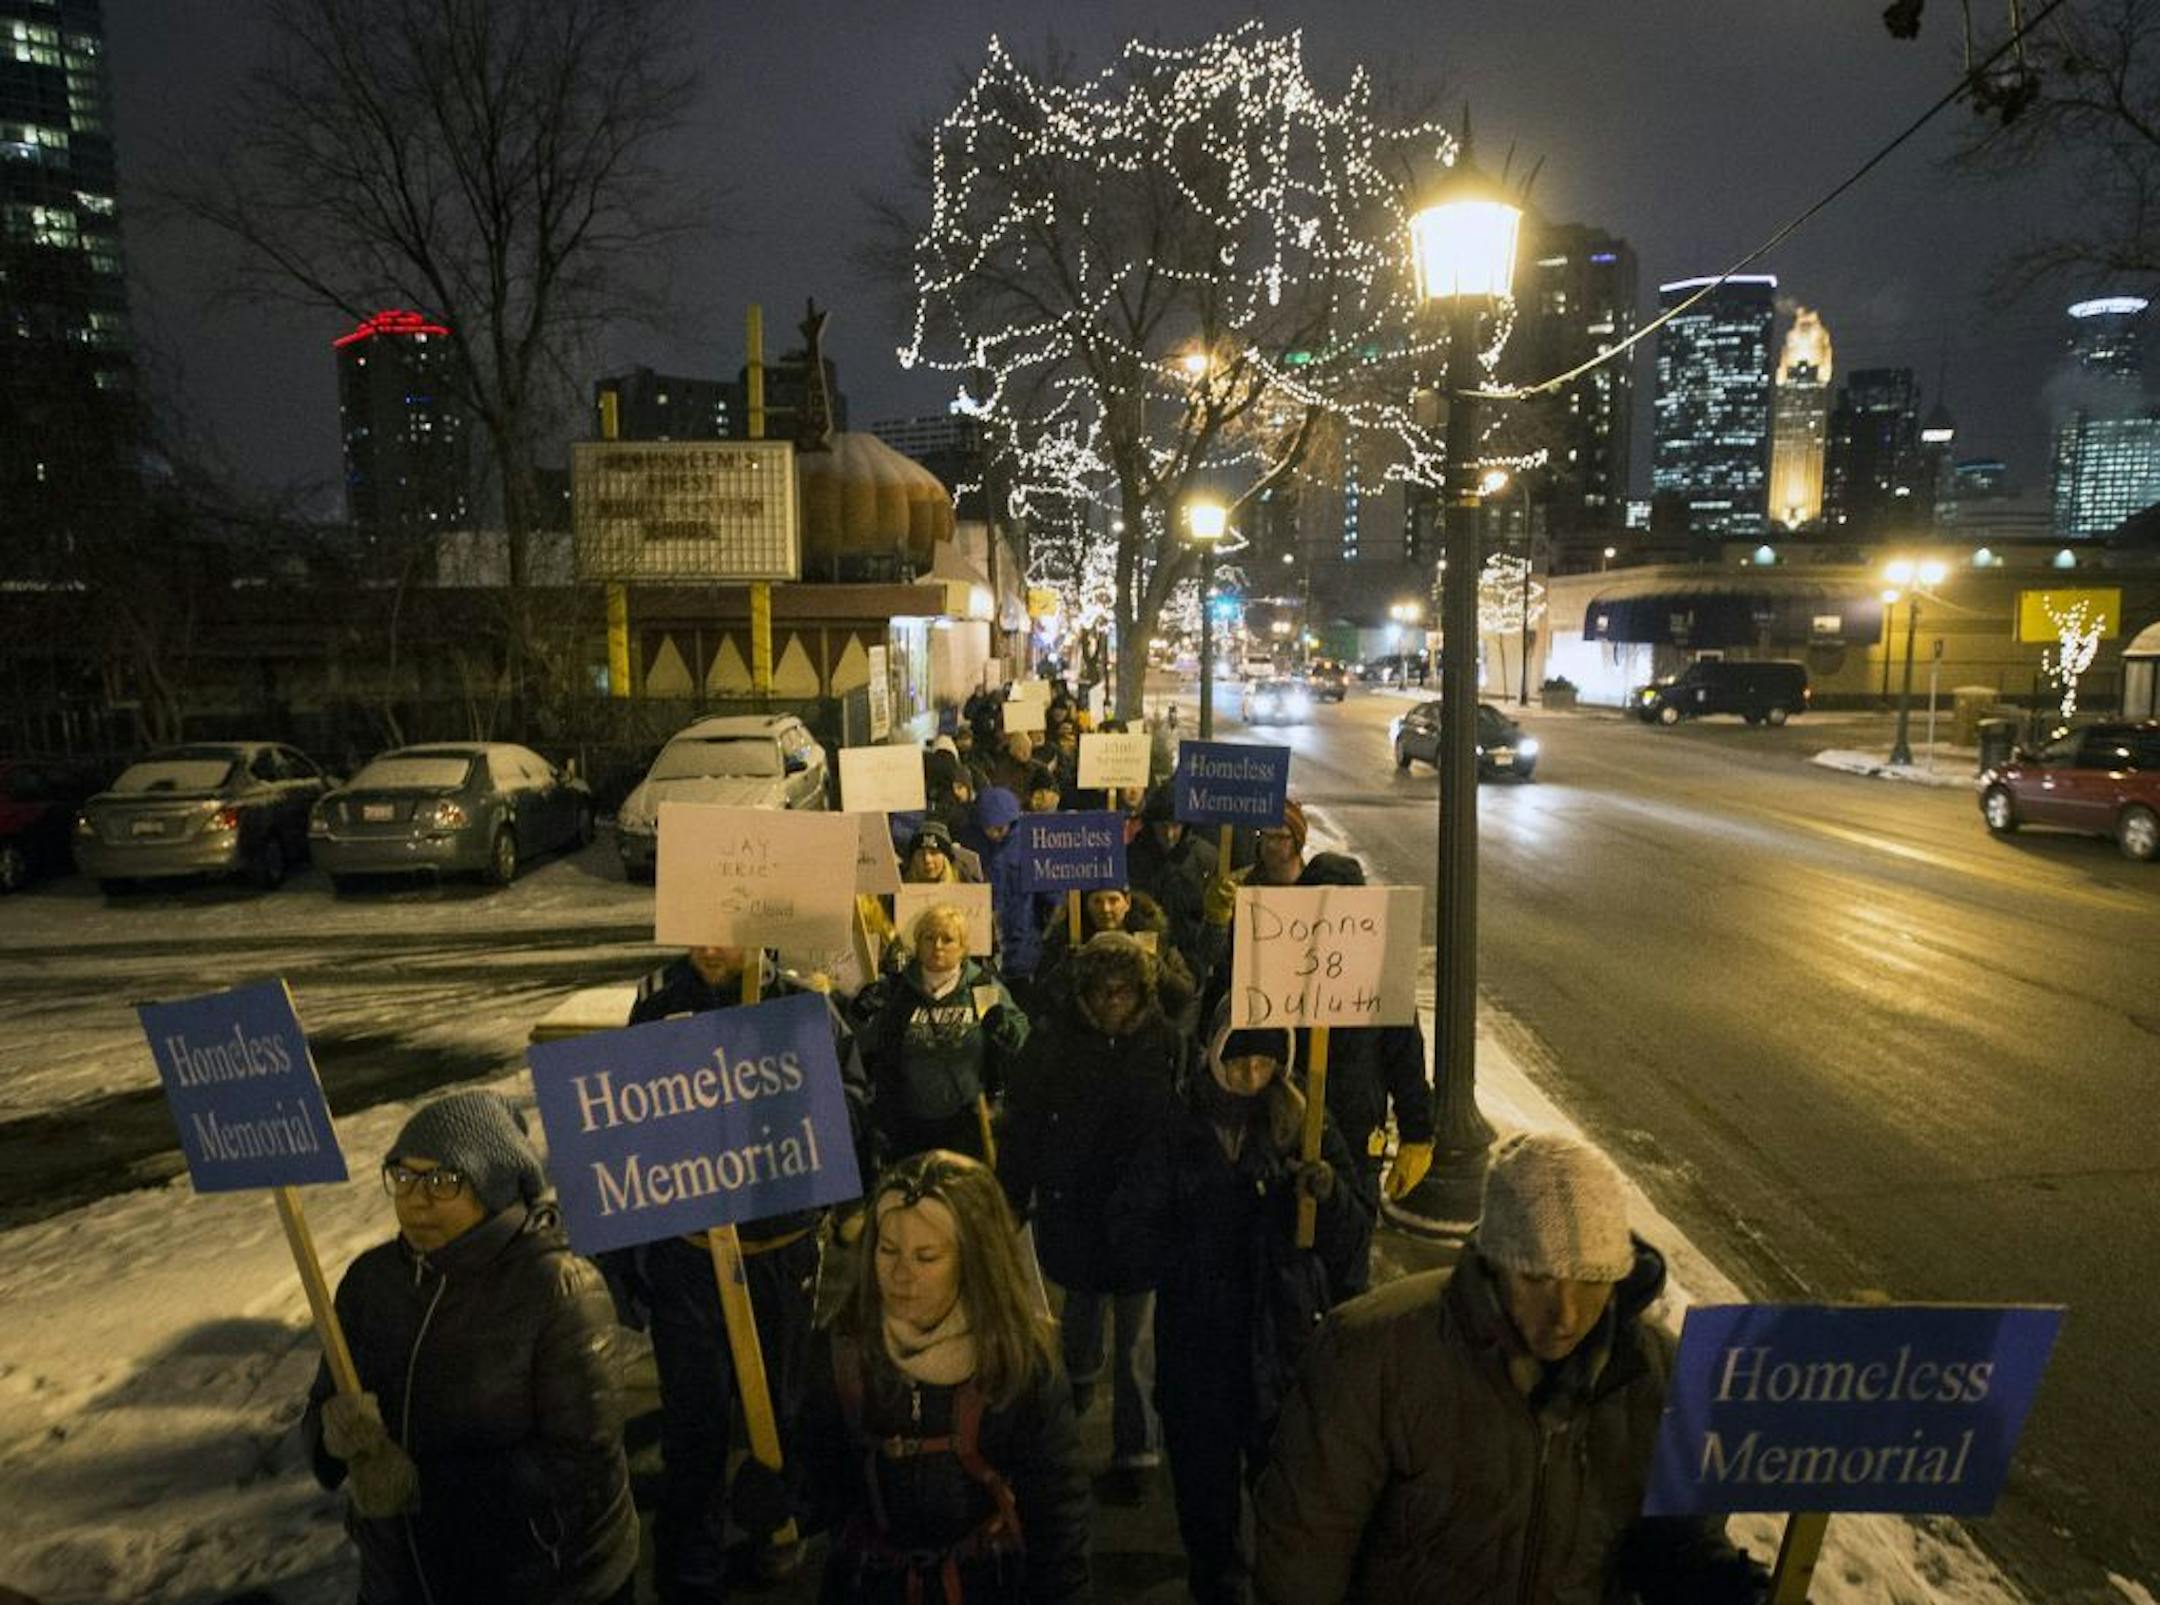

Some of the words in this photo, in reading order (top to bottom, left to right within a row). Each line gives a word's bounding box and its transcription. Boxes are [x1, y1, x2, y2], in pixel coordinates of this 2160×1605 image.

[1189, 753, 1276, 780] Homeless
[1188, 788, 1274, 815] Memorial
[1031, 826, 1112, 850] Homeless
[1033, 857, 1114, 880] Memorial
[1247, 901, 1379, 942] Donna
[166, 1023, 292, 1087] Homeless
[570, 1046, 803, 1133] Homeless
[191, 1098, 320, 1163] Memorial
[590, 1116, 824, 1218] Memorial
[1717, 1345, 1994, 1402] Homeless
[1697, 1429, 1975, 1485] Memorial
